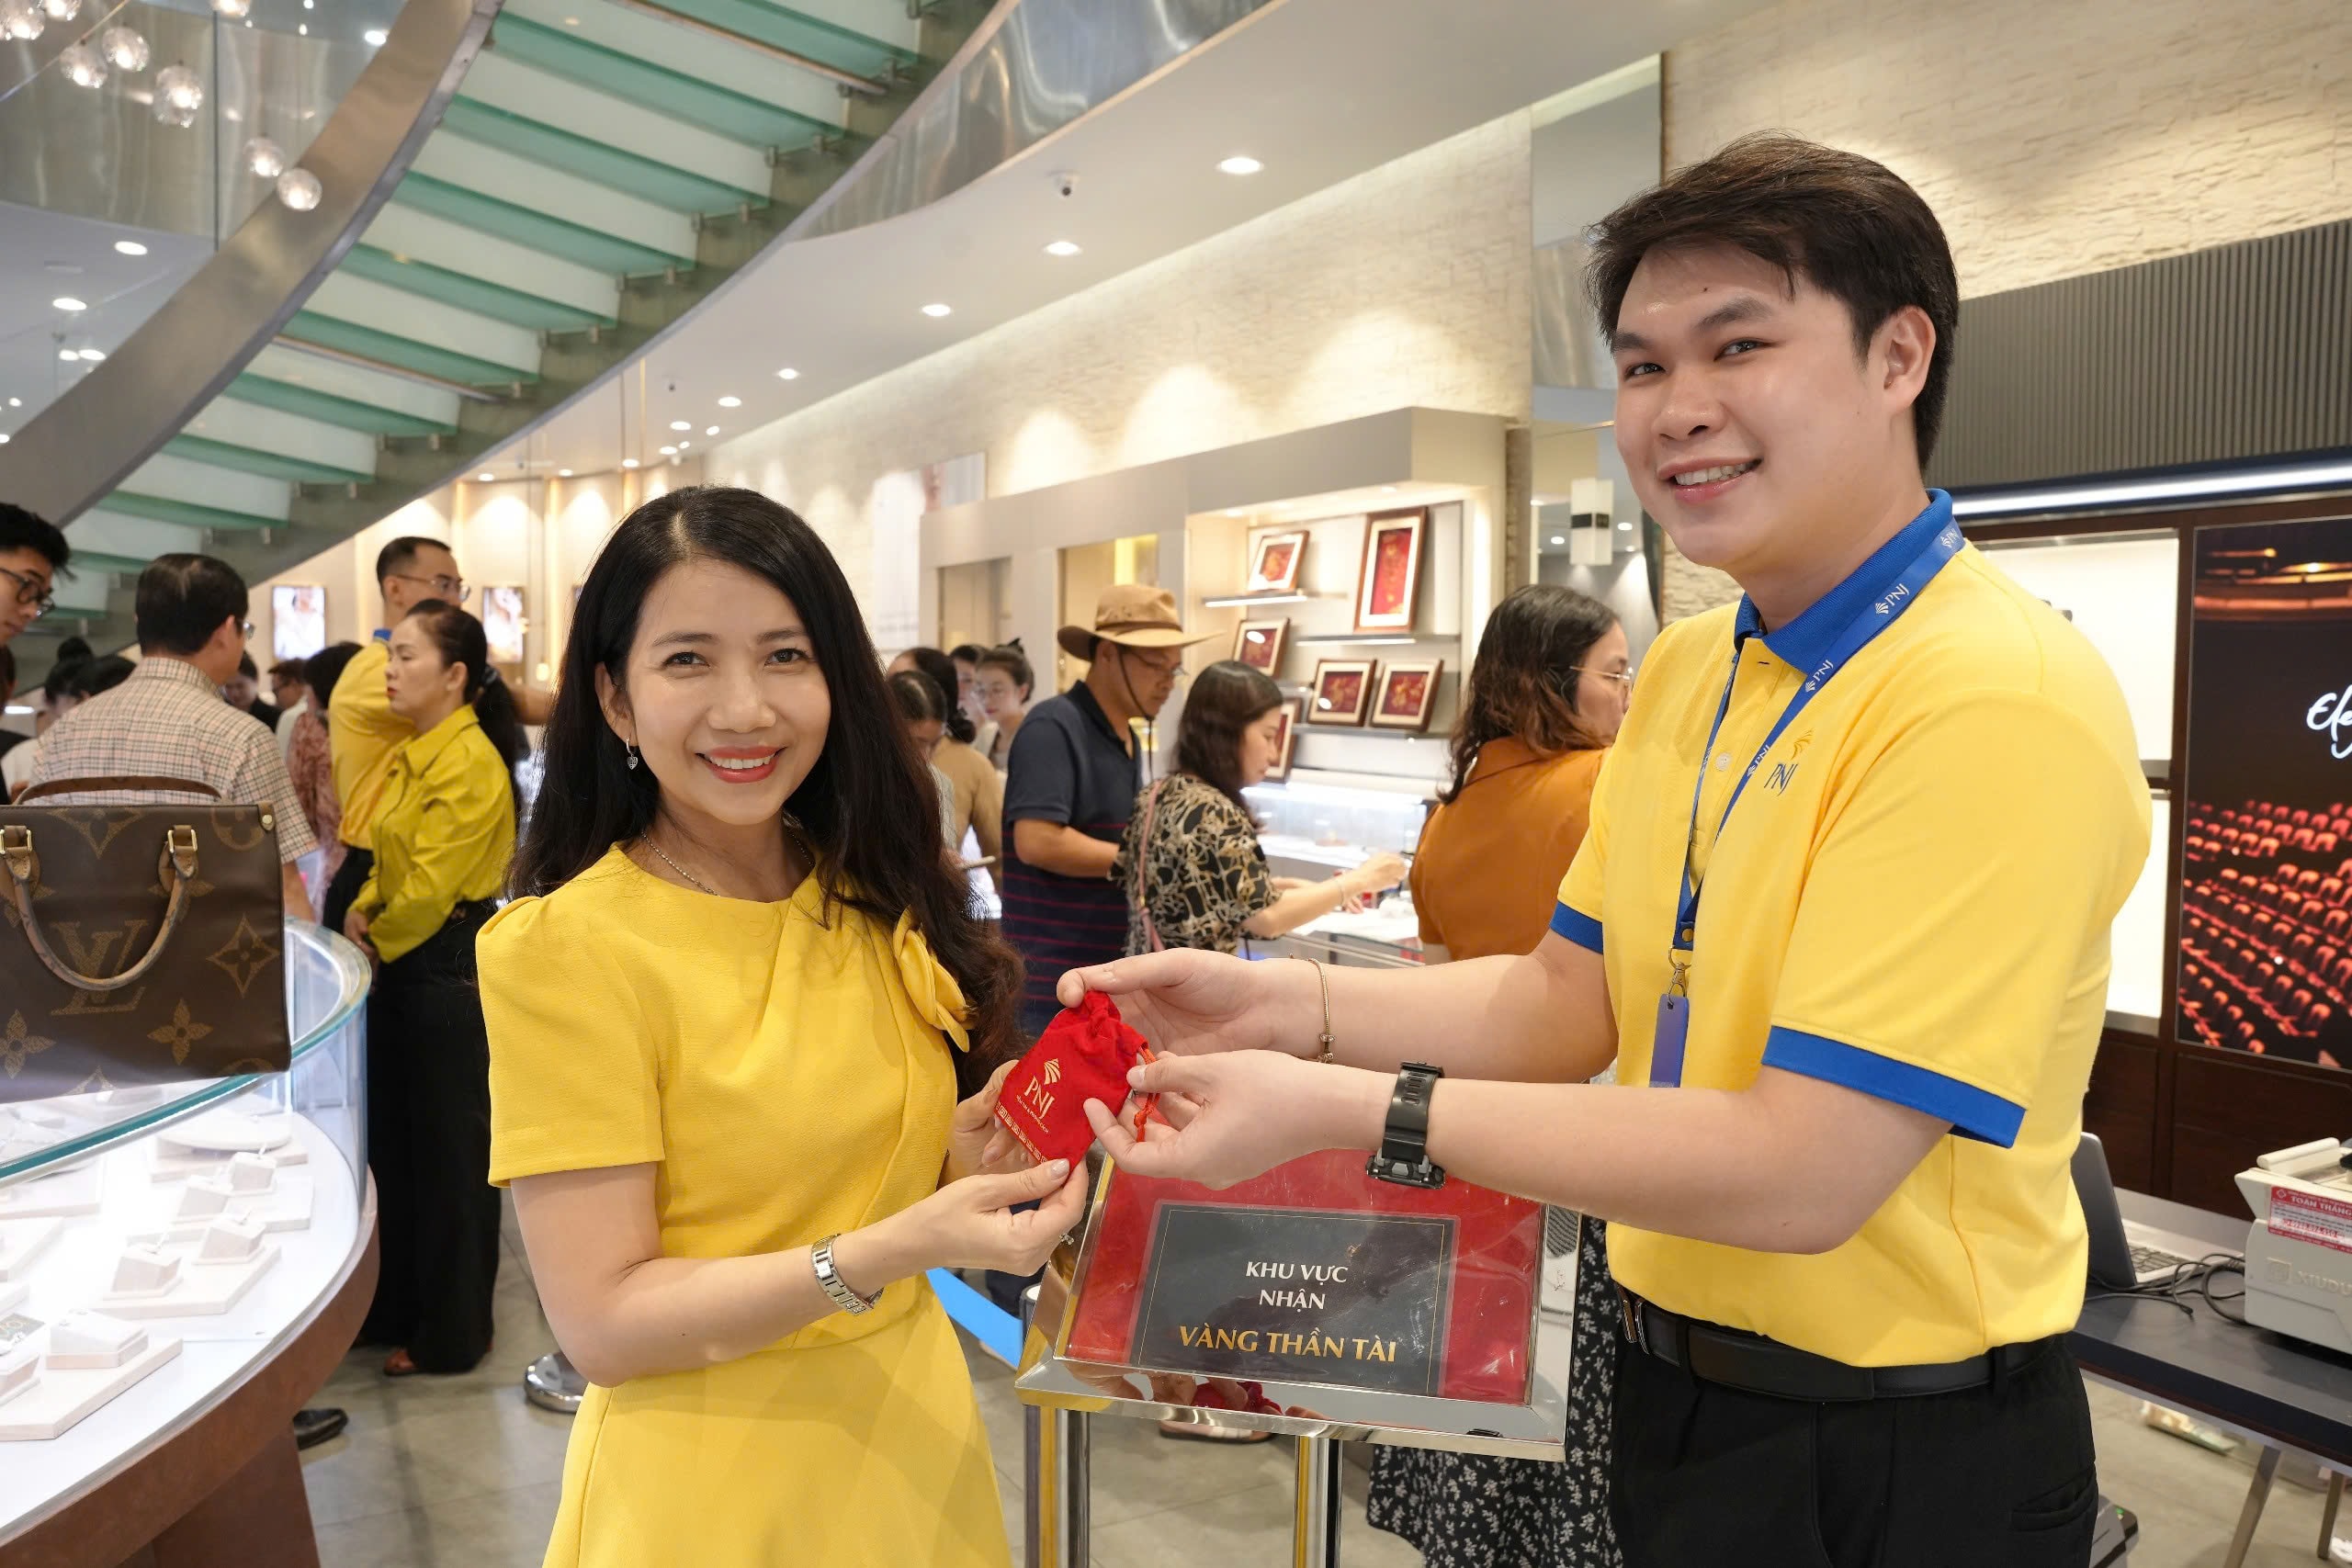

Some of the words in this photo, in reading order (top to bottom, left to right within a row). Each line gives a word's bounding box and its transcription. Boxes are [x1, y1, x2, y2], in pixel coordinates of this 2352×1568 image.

[1884, 582, 1910, 606] PNJ
[1812, 660, 1834, 682] PNJ
[1763, 762, 1799, 797] PNJ
[1023, 1075, 1055, 1120] PNJ
[1245, 1261, 1295, 1280] KHU
[1300, 1264, 1349, 1286] VỰC
[1259, 1288, 1327, 1313] NHẬN
[1179, 1322, 1259, 1352] VÀNG
[1266, 1326, 1345, 1359] THẦN
[1352, 1335, 1397, 1363] TÀI
